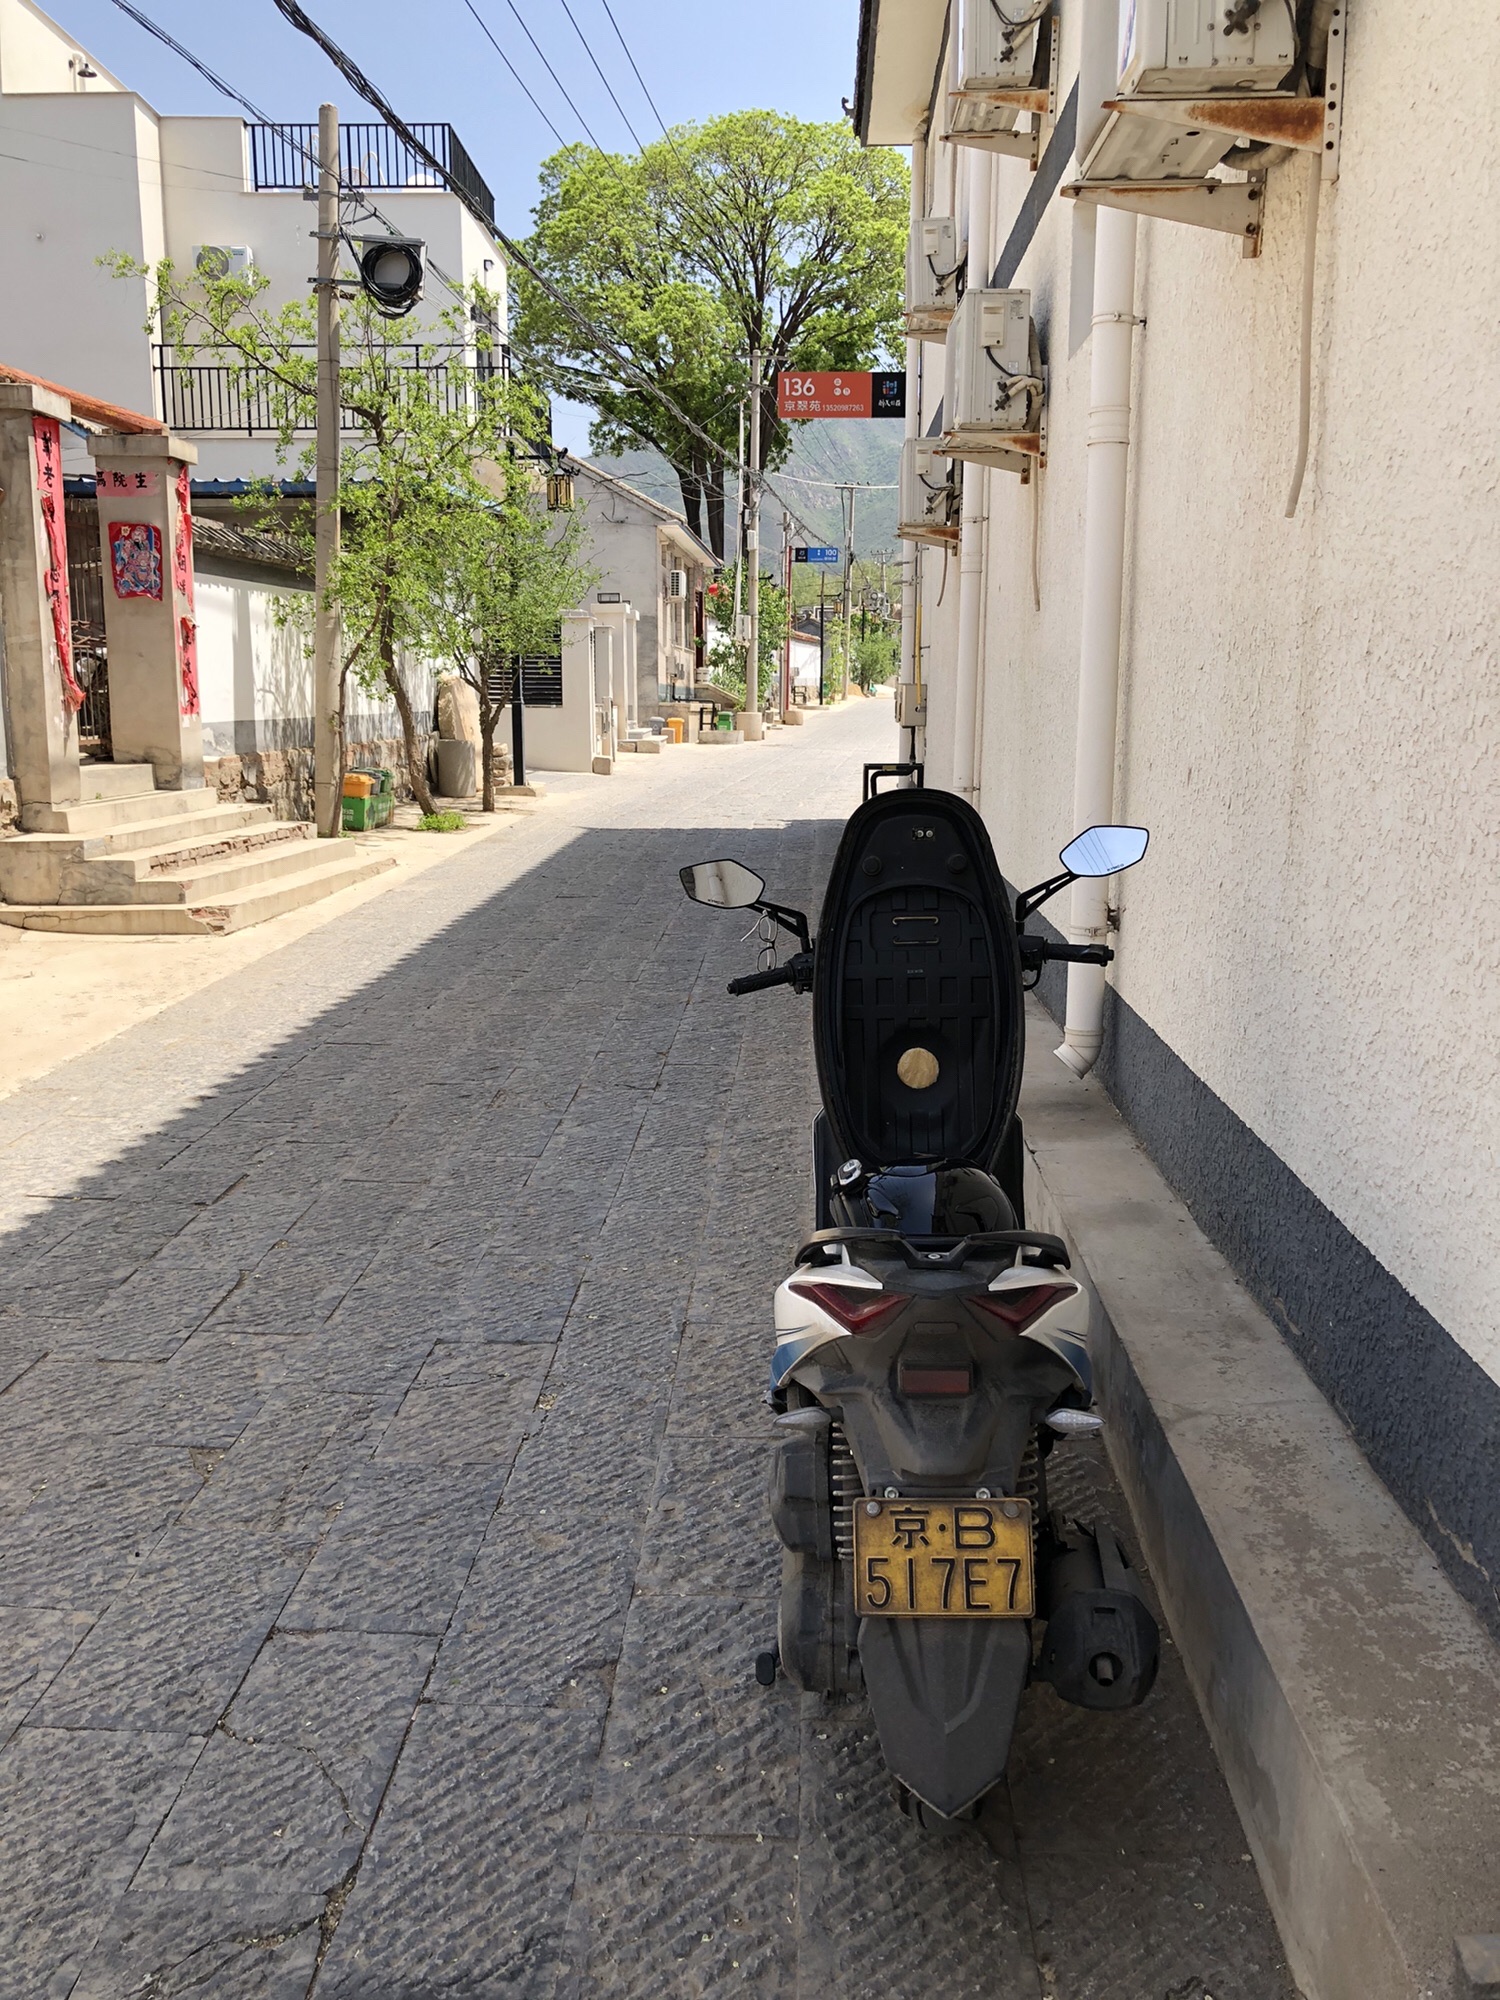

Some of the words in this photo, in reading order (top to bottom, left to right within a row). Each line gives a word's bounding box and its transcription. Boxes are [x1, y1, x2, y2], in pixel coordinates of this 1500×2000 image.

[784, 378, 815, 396] 136
[784, 400, 821, 412] 京翠苑
[866, 1557, 1022, 1610] 517E7
